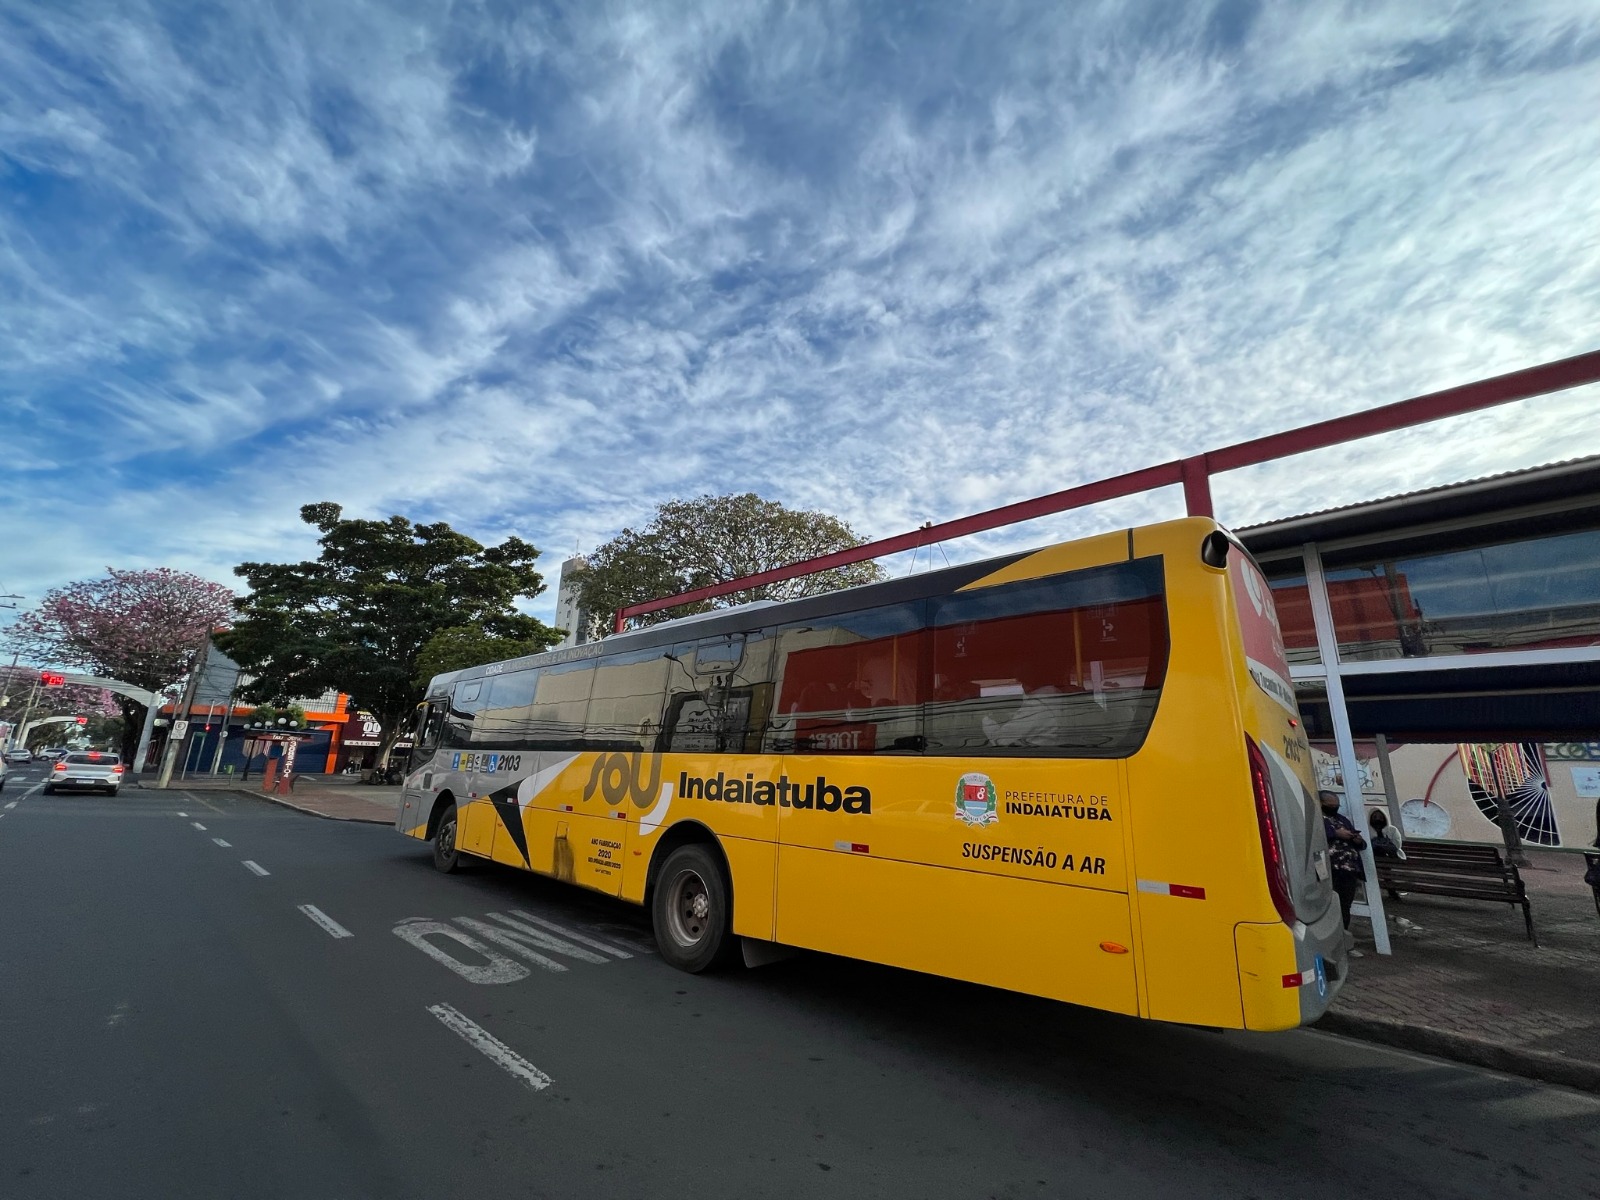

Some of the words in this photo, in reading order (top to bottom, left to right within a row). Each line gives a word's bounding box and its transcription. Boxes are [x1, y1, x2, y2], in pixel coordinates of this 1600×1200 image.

[485, 663, 504, 675] CIDADE
[569, 644, 604, 660] INOVAÇÃO
[497, 755, 521, 771] 2103
[678, 771, 872, 815] Indaiatuba
[1005, 790, 1084, 805] PREFEITURA
[1090, 795, 1108, 806] DE
[1005, 802, 1113, 822] INDAIATUBA
[597, 849, 612, 859] 2020
[961, 842, 1057, 869] SUSPENSÃO
[1062, 854, 1075, 871] A
[1079, 856, 1106, 875] AR
